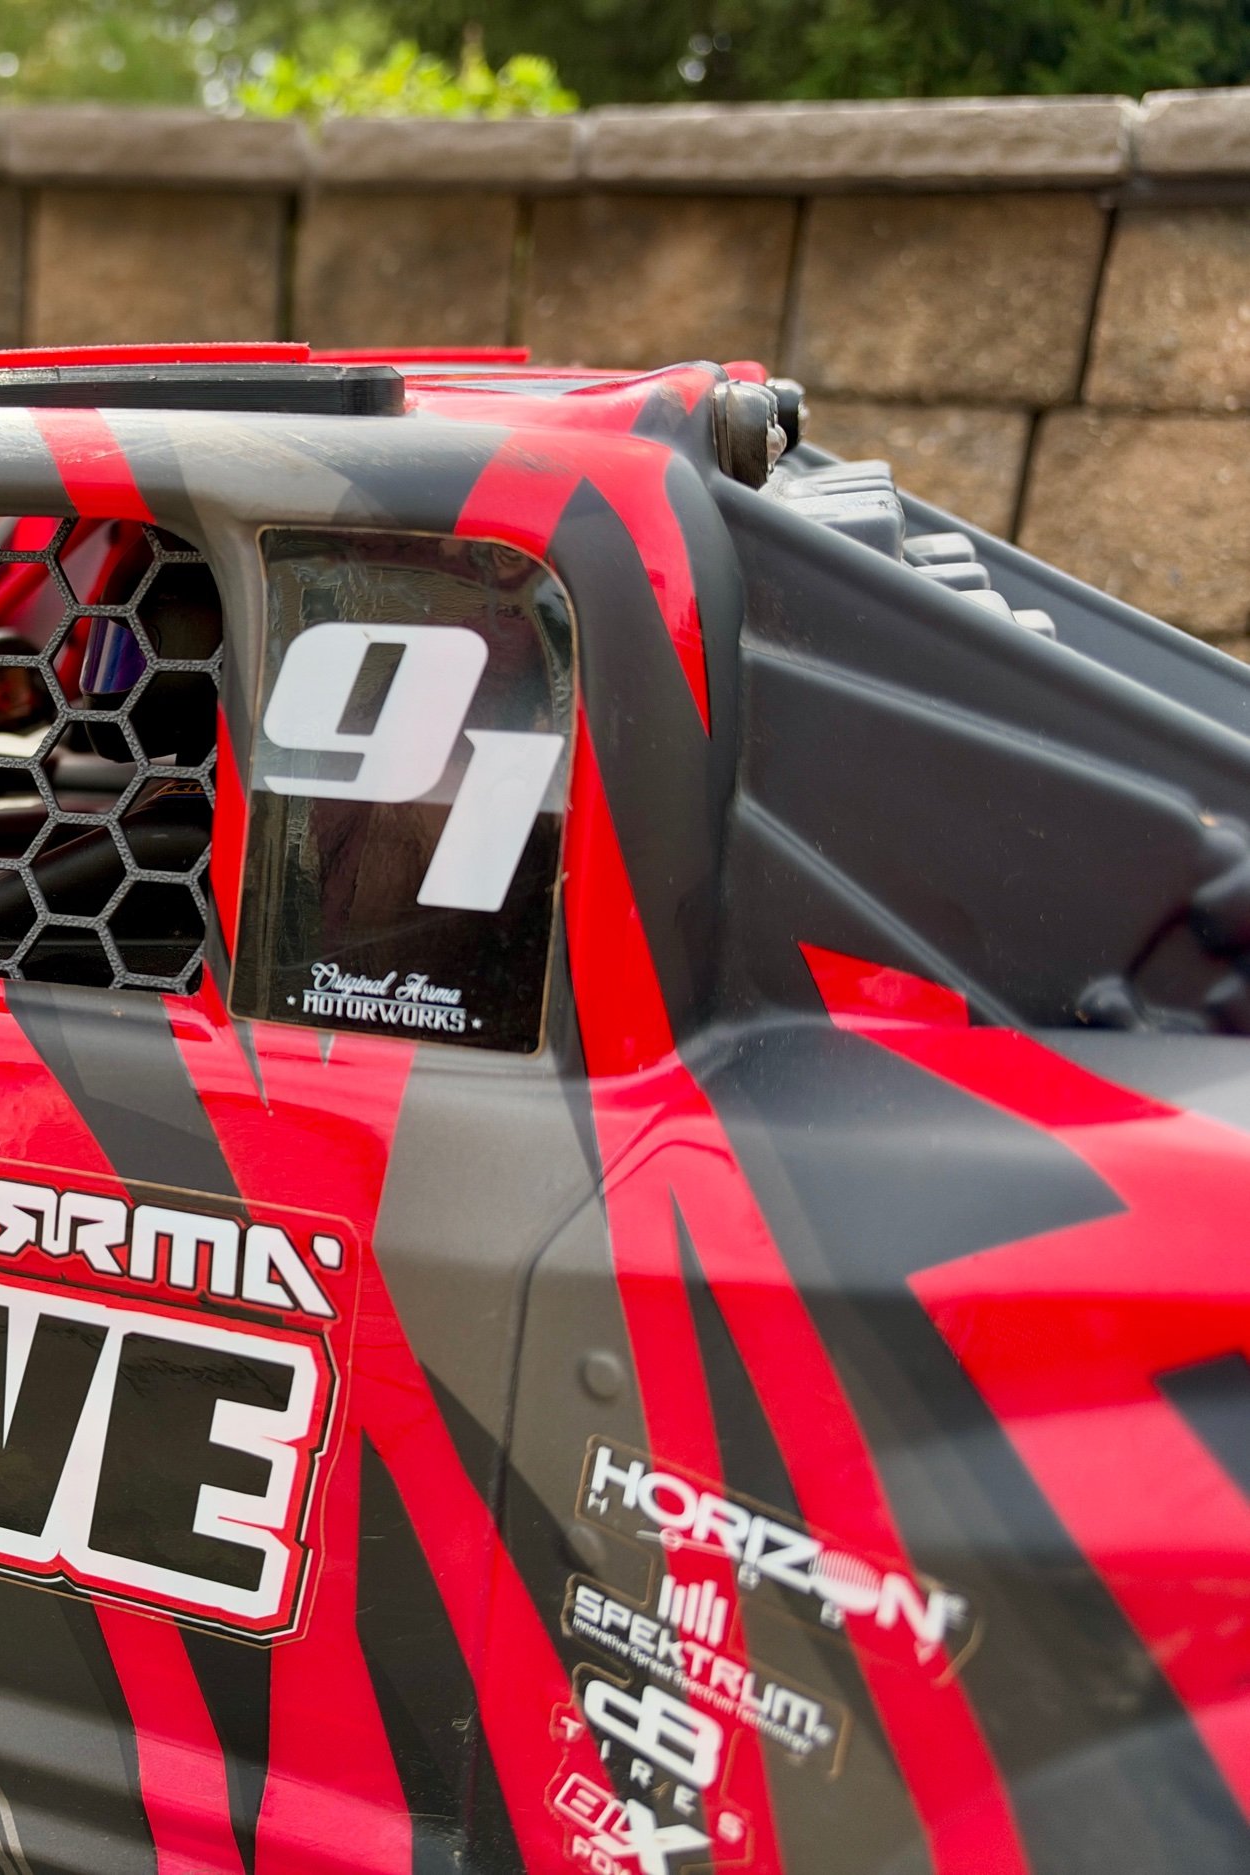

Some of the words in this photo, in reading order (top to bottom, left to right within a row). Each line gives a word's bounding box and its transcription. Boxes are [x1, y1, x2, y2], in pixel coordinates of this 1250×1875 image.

[262, 620, 565, 913] 91
[302, 994, 467, 1034] MOTORWORKS
[311, 962, 398, 997] Original
[395, 972, 463, 1005] Arrma
[590, 1446, 950, 1643] HORIZON
[574, 1584, 824, 1737] SPEKTRUM
